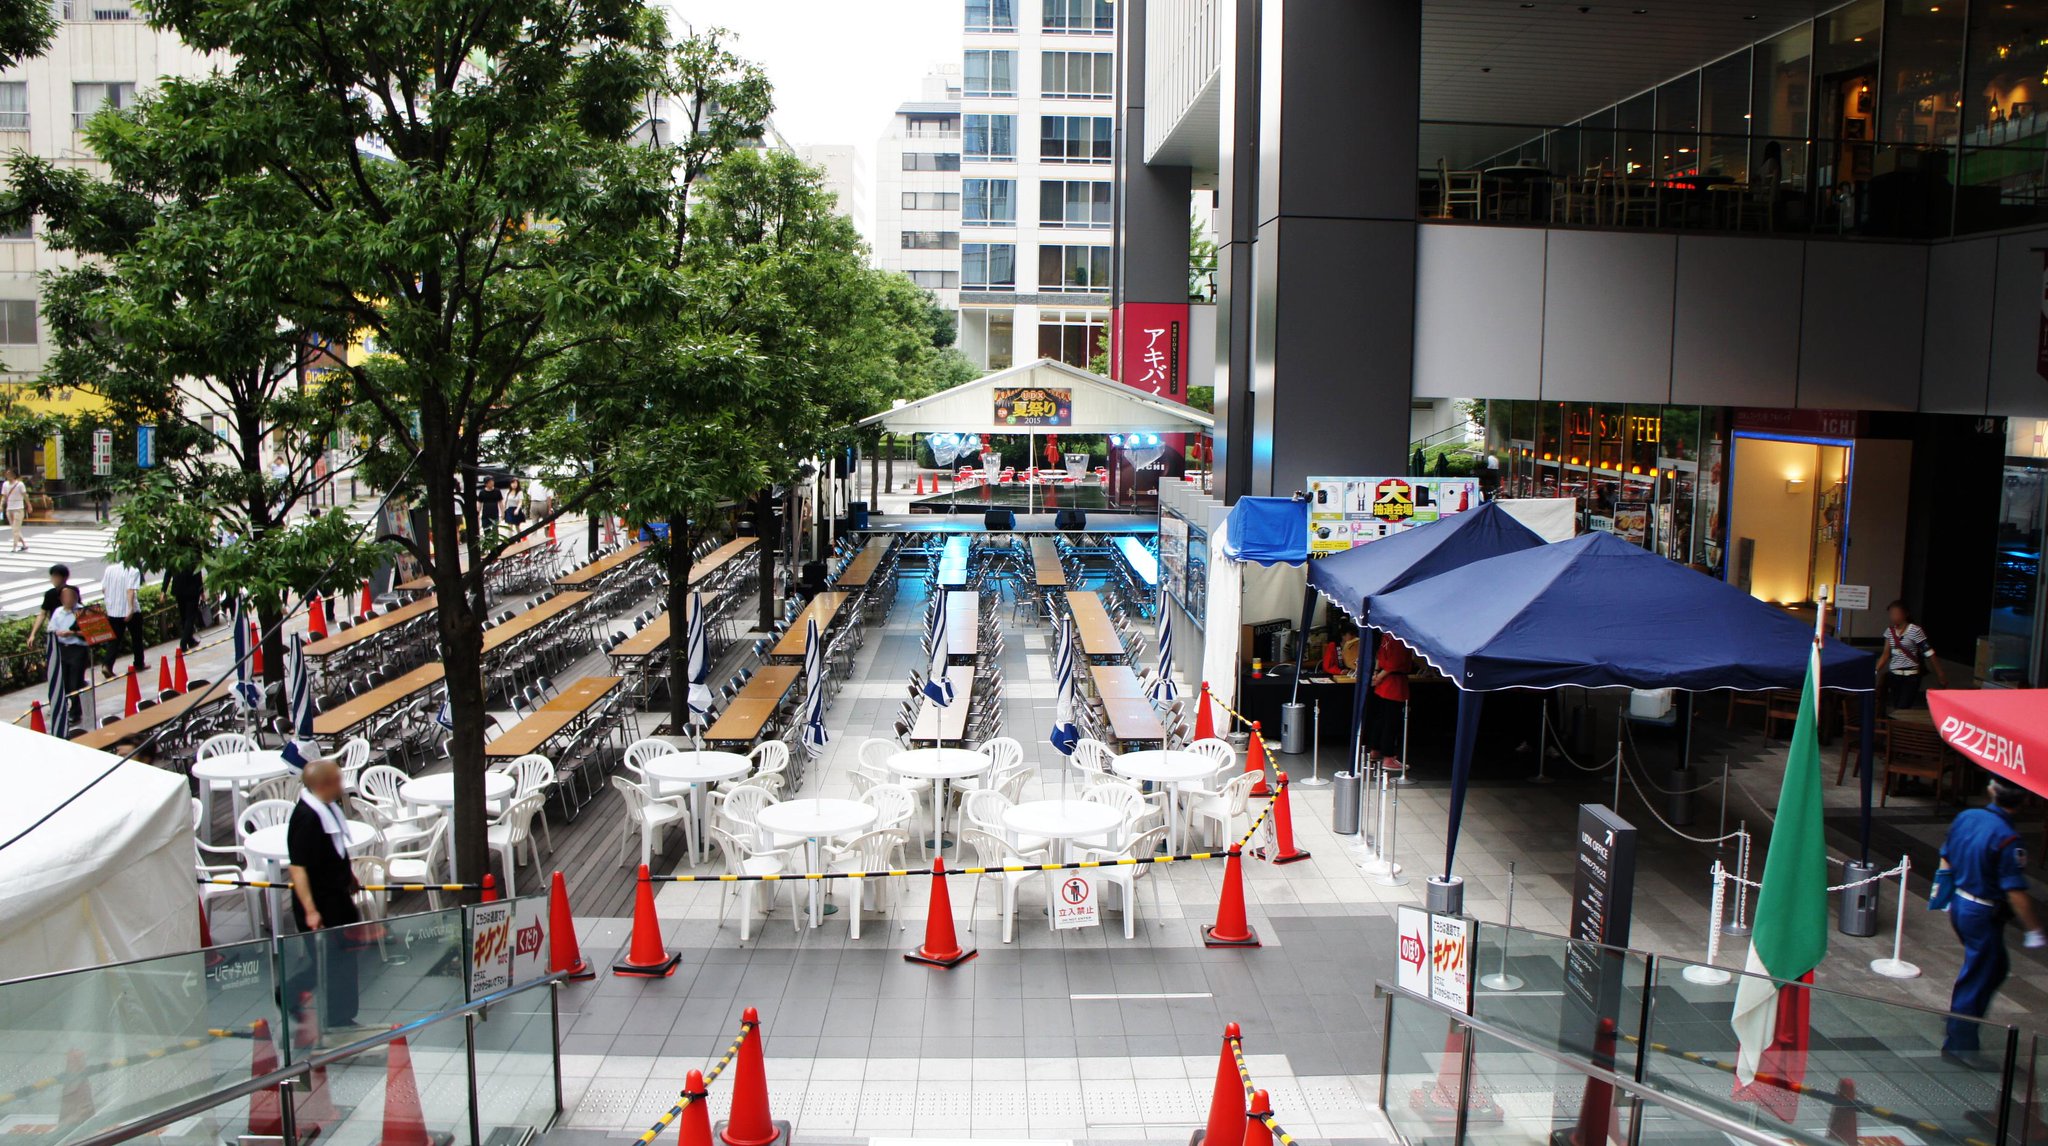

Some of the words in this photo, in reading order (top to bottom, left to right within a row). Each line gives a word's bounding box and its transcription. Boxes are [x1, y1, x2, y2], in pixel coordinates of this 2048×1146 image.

[1023, 390, 1045, 400] UDX
[1012, 400, 1057, 417] 夏祭り
[1024, 417, 1041, 425] 2015
[1823, 418, 1856, 434] ICHI
[1375, 480, 1411, 503] 大
[1373, 503, 1414, 516] 抽選会場
[1941, 716, 2026, 774] PIZZERIA
[1592, 842, 1609, 860] OFFICE
[1059, 906, 1095, 916] 立入禁止
[520, 929, 539, 951] くだり
[1403, 939, 1421, 962] のぼり
